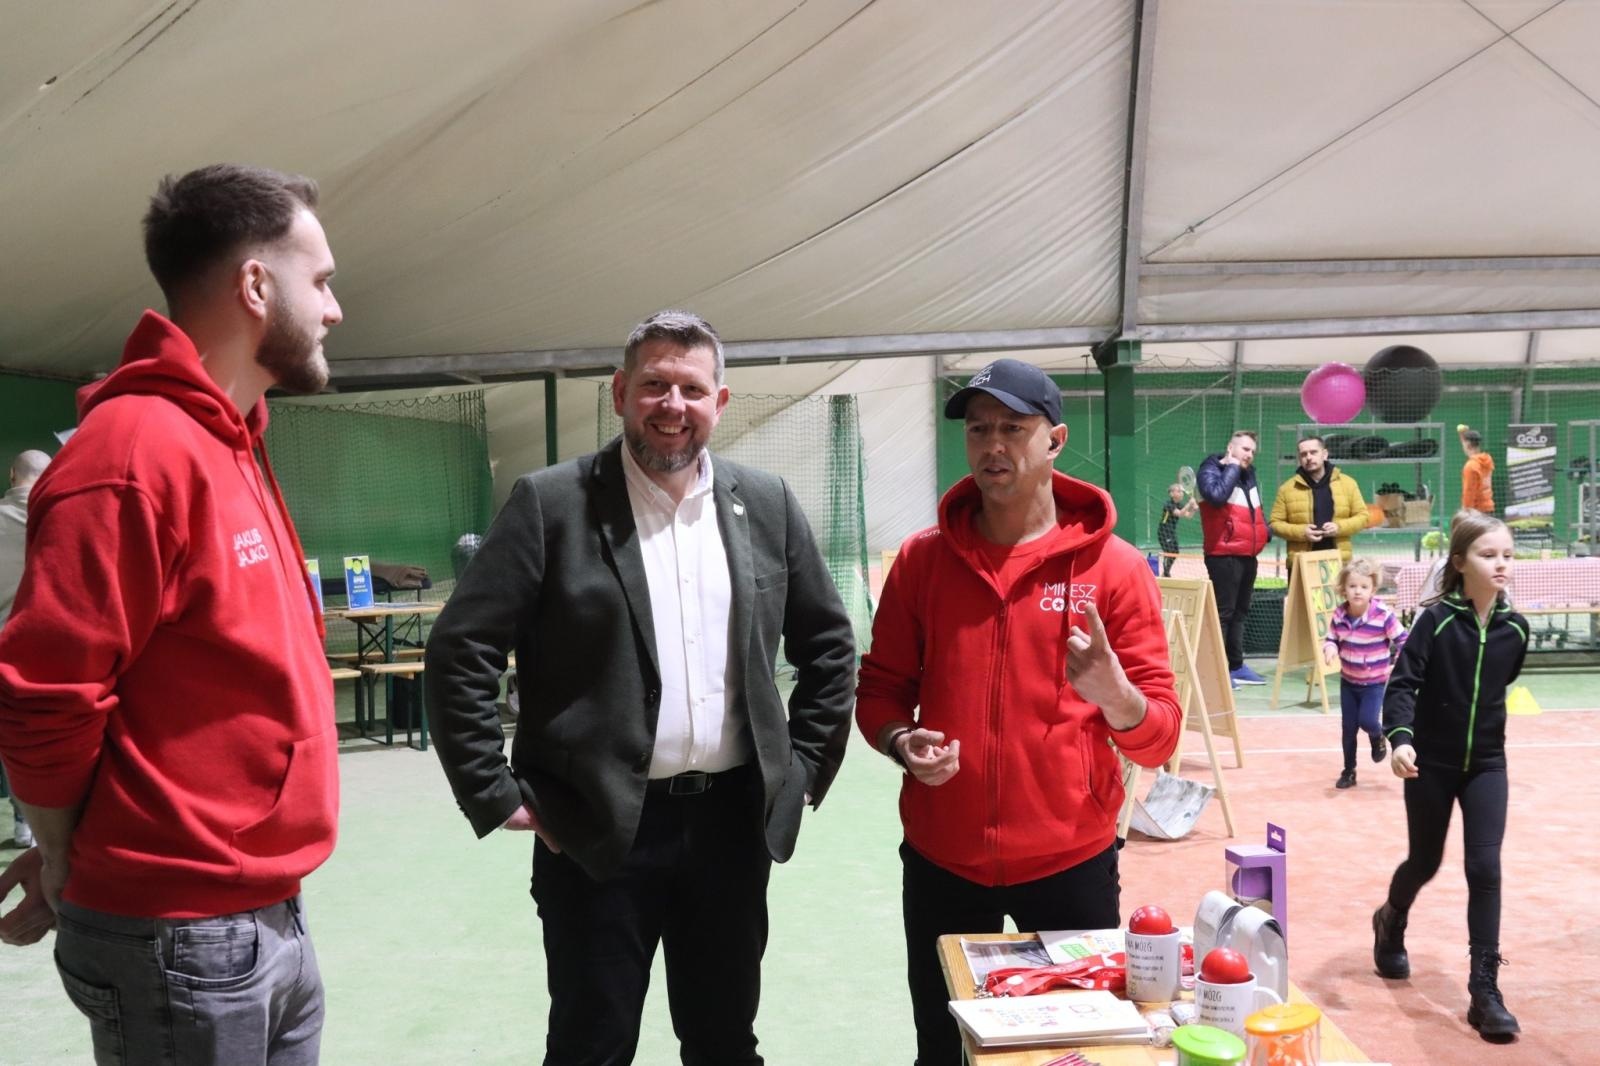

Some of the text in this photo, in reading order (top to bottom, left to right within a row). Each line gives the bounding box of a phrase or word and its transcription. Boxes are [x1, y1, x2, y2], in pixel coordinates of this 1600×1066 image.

[1516, 434, 1548, 444] GOLD
[232, 528, 262, 550] JAKUB
[1043, 582, 1097, 599] MIKESZ
[1039, 597, 1095, 614] COAC
